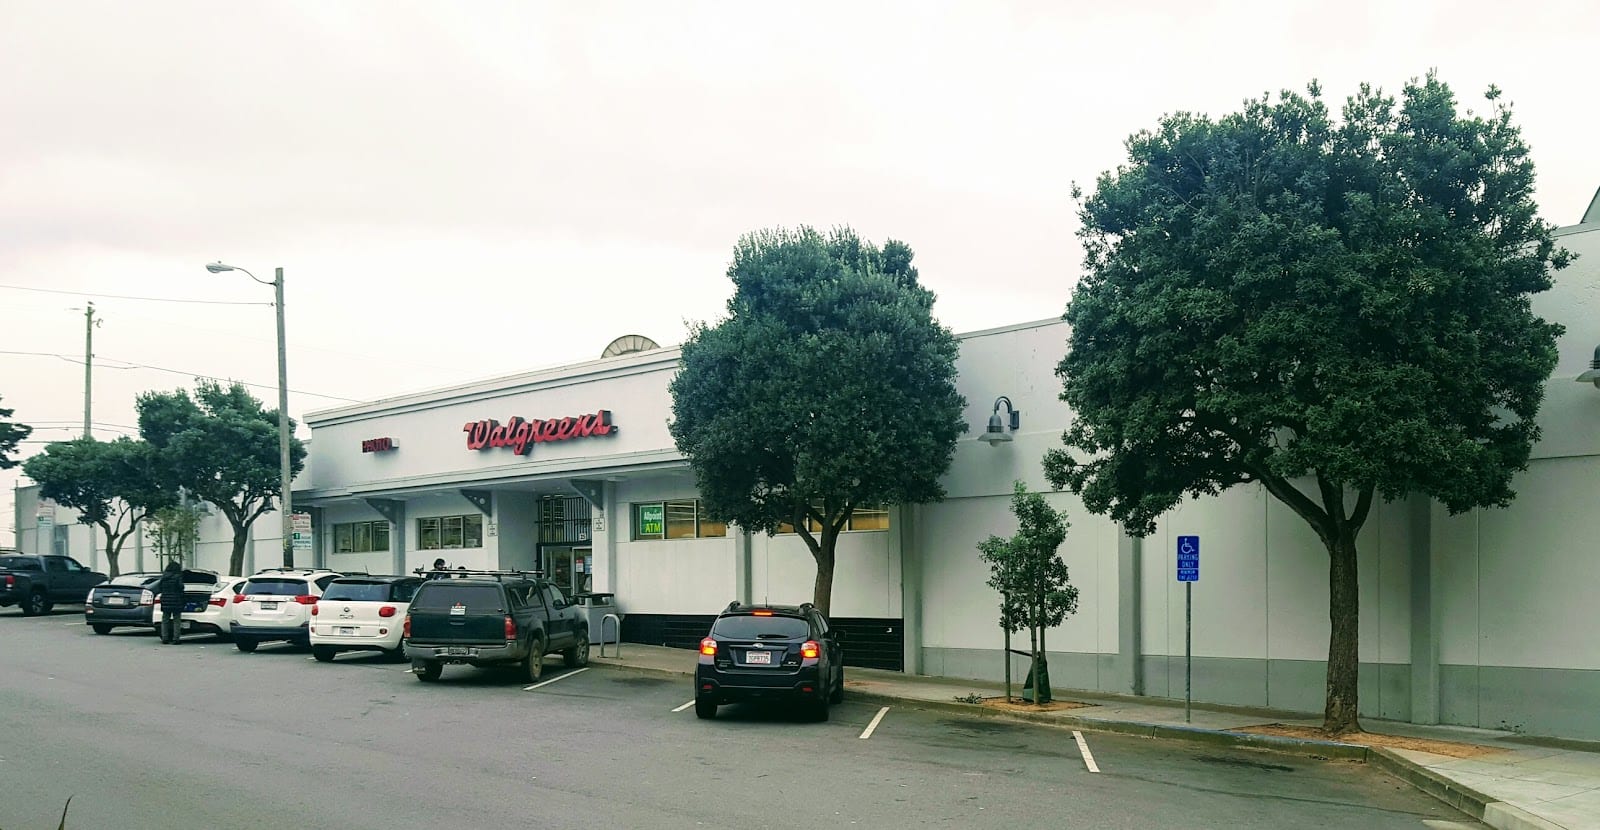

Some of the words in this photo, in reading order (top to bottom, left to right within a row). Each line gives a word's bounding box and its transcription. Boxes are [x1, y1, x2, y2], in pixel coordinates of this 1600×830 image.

[463, 409, 611, 455] Walgreens
[362, 437, 391, 453] PHOTO
[645, 522, 661, 533] ATM
